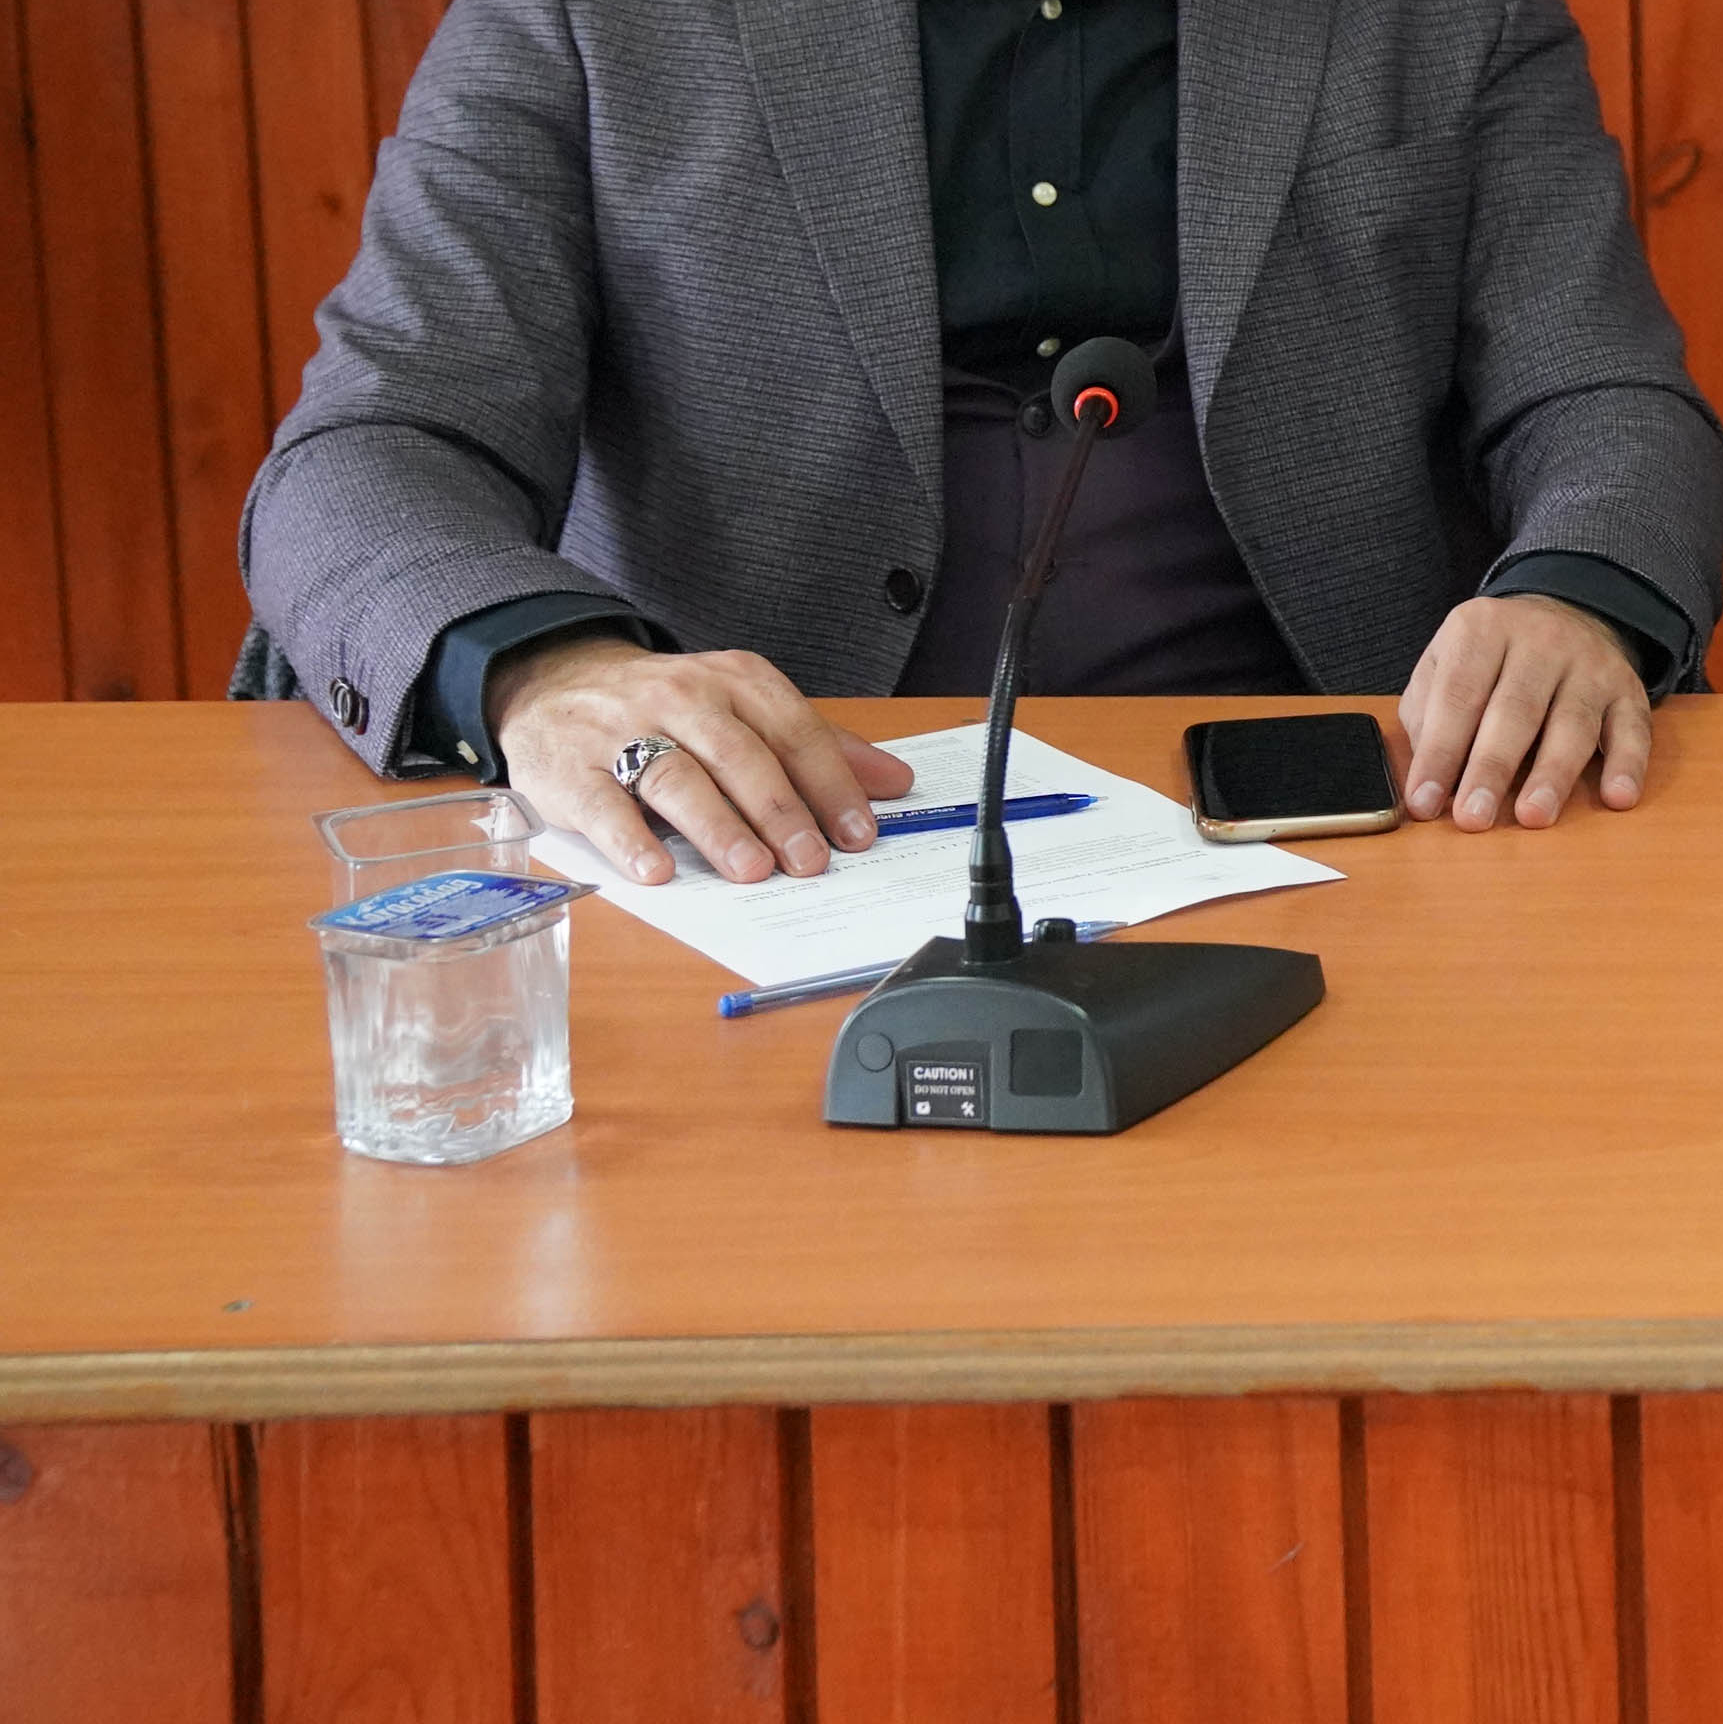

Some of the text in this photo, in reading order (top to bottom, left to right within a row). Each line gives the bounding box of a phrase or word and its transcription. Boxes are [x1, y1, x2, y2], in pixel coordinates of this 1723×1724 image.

[913, 1066, 967, 1081] CAUTION
[914, 1084, 976, 1096] DO NOT OPEN
